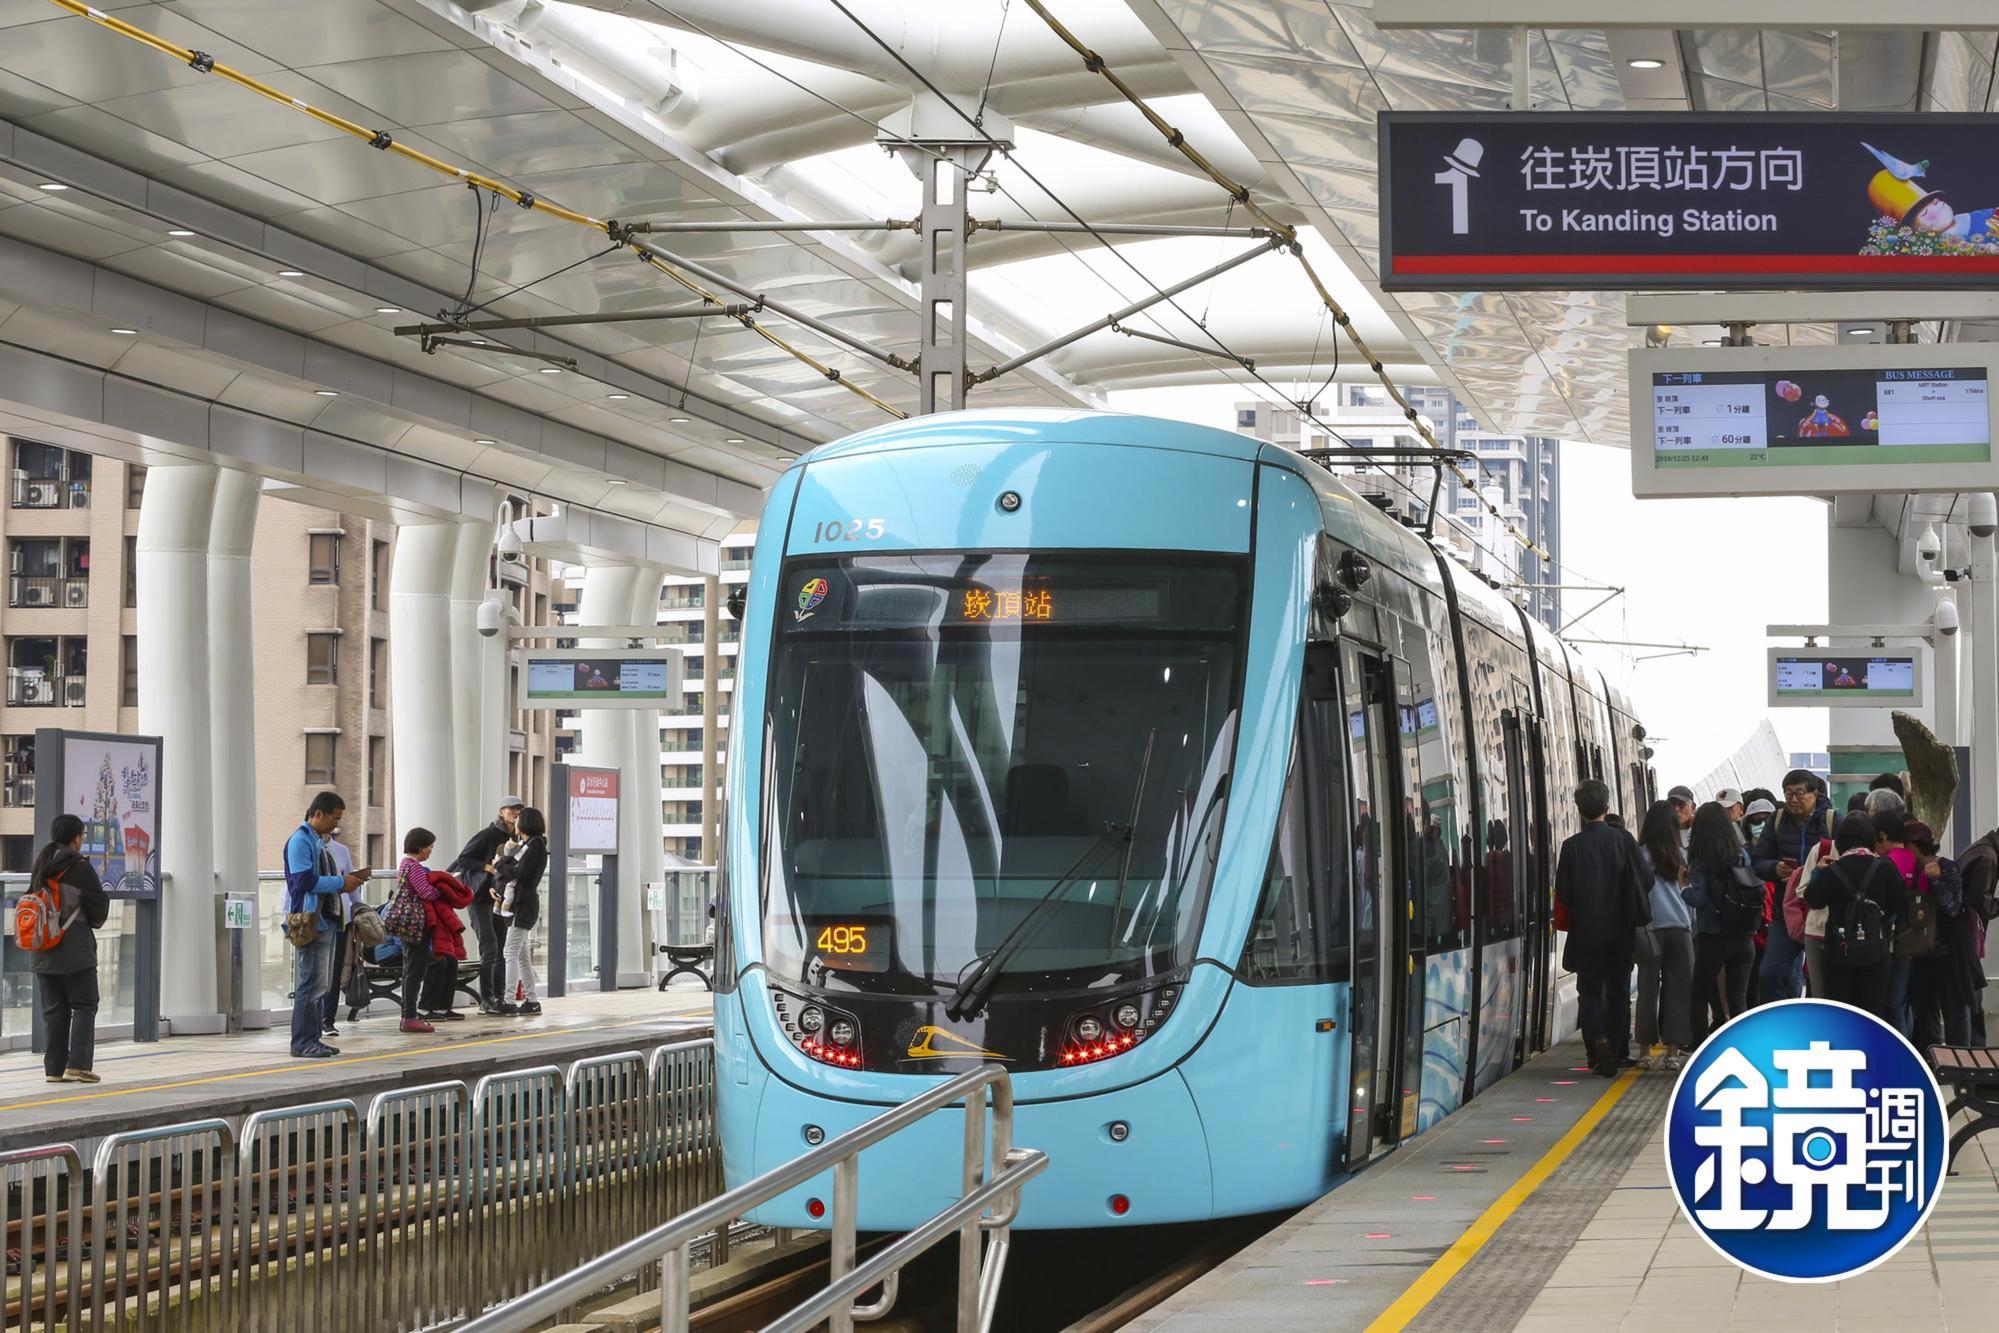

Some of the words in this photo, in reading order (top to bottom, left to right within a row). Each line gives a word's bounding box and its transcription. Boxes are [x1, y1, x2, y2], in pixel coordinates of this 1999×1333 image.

[1519, 145, 1803, 192] 往崁頂站方向
[1519, 209, 1553, 232] To
[1561, 209, 1674, 237] Kanding
[1683, 209, 1778, 232] Station
[1662, 373, 1702, 384] 下一列車
[1886, 371, 1905, 379] BUS
[1907, 370, 1955, 379] MESSAGE
[1657, 405, 1690, 415] 下一列車
[1658, 436, 1691, 445] 下一列車
[814, 518, 885, 543] 1025
[964, 590, 1051, 618] 崁頂站
[817, 926, 866, 953] 495
